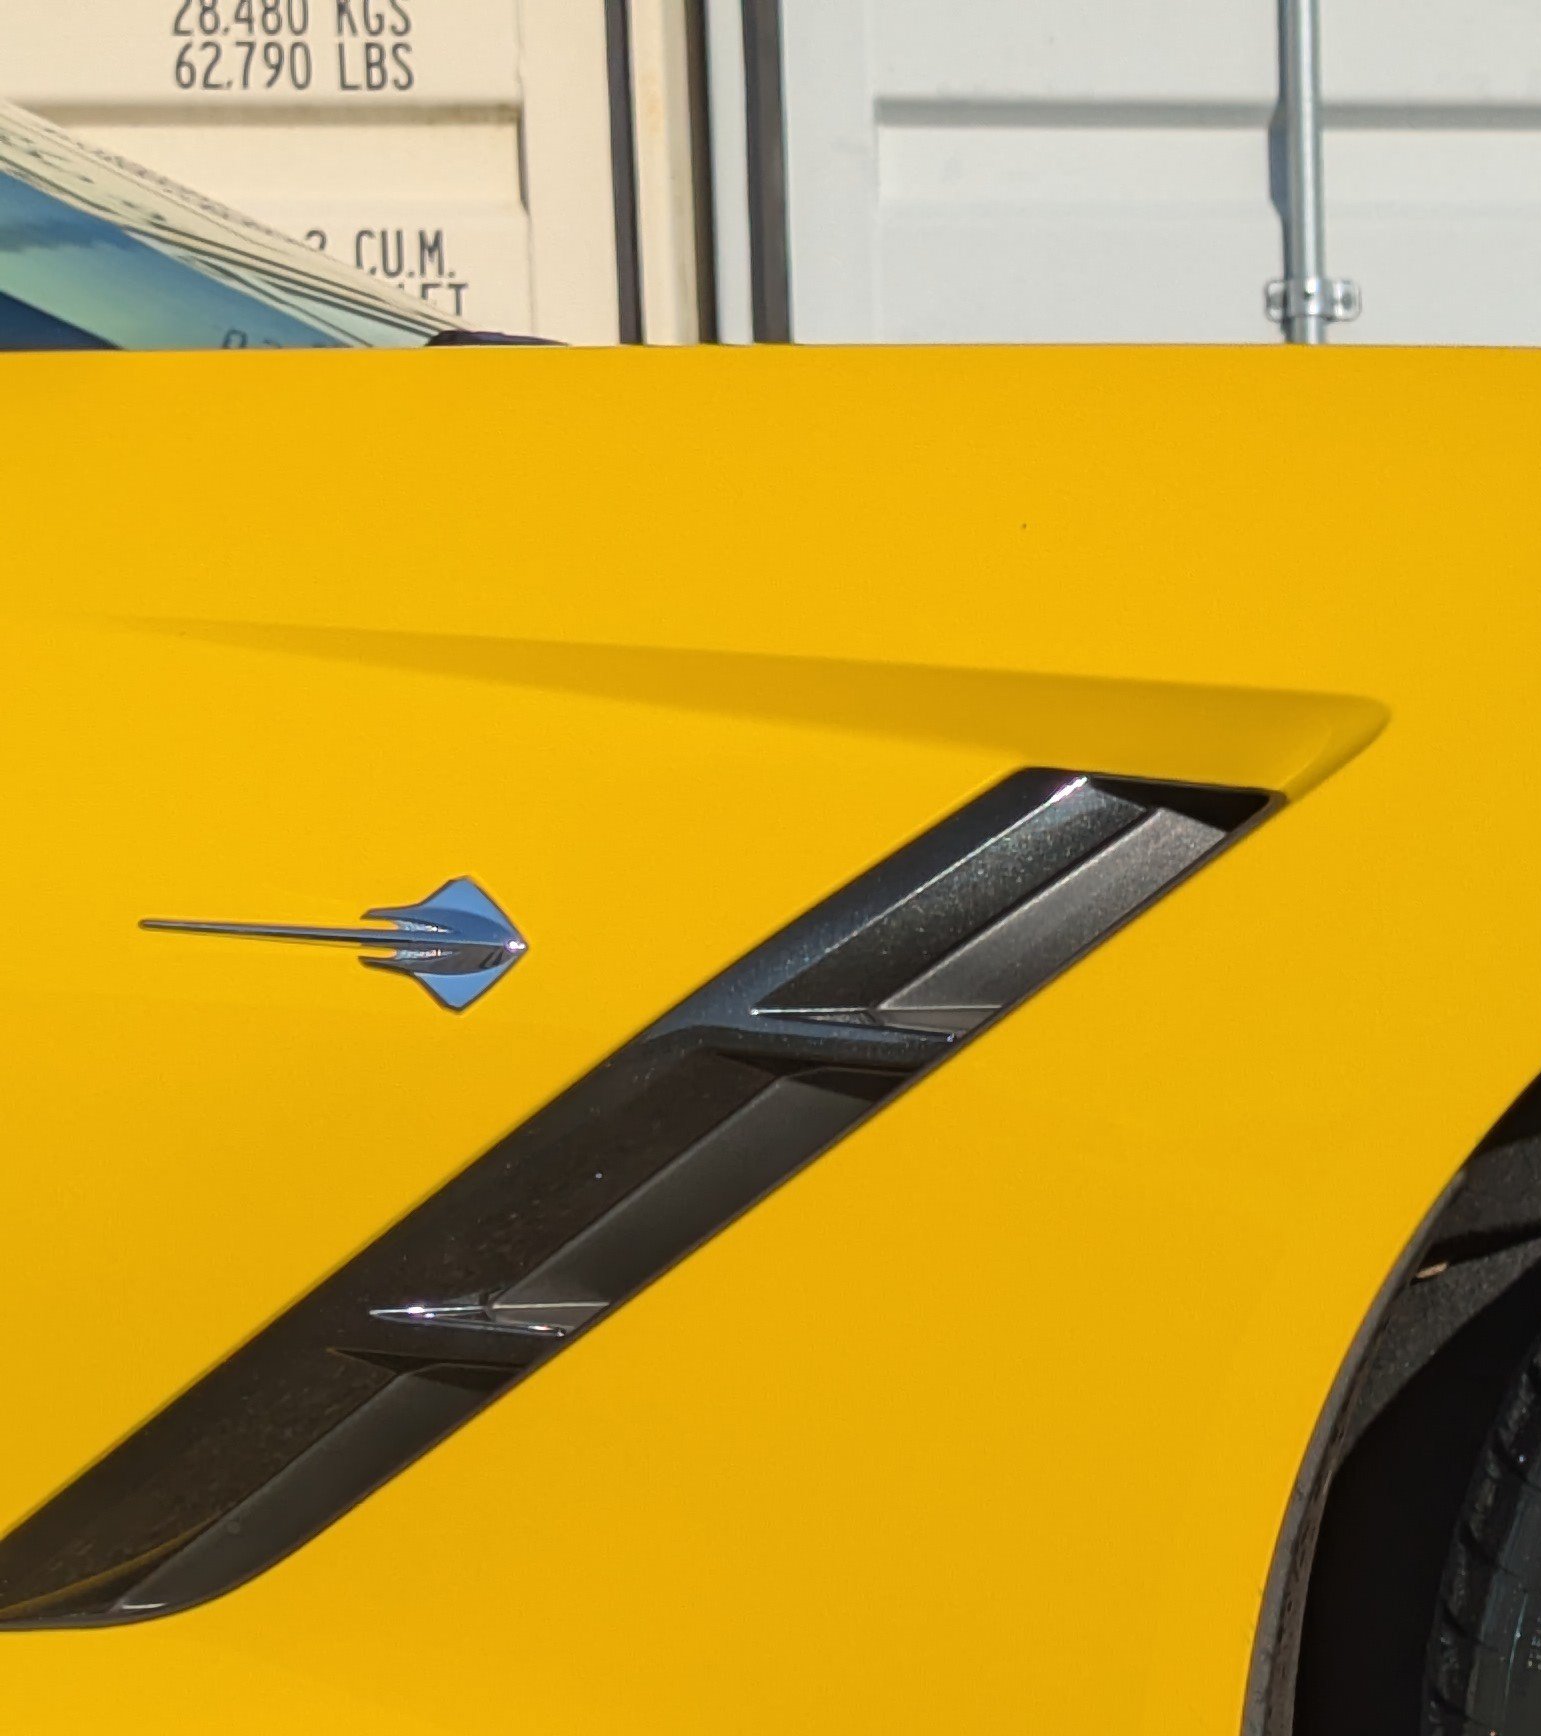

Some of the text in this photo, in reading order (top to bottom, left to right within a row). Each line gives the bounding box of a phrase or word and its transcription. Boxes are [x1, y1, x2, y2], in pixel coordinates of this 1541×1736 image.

[172, 0, 413, 36] 28.480 KGS
[174, 41, 415, 90] 62.790 LBS
[355, 229, 456, 278] CU.M.
